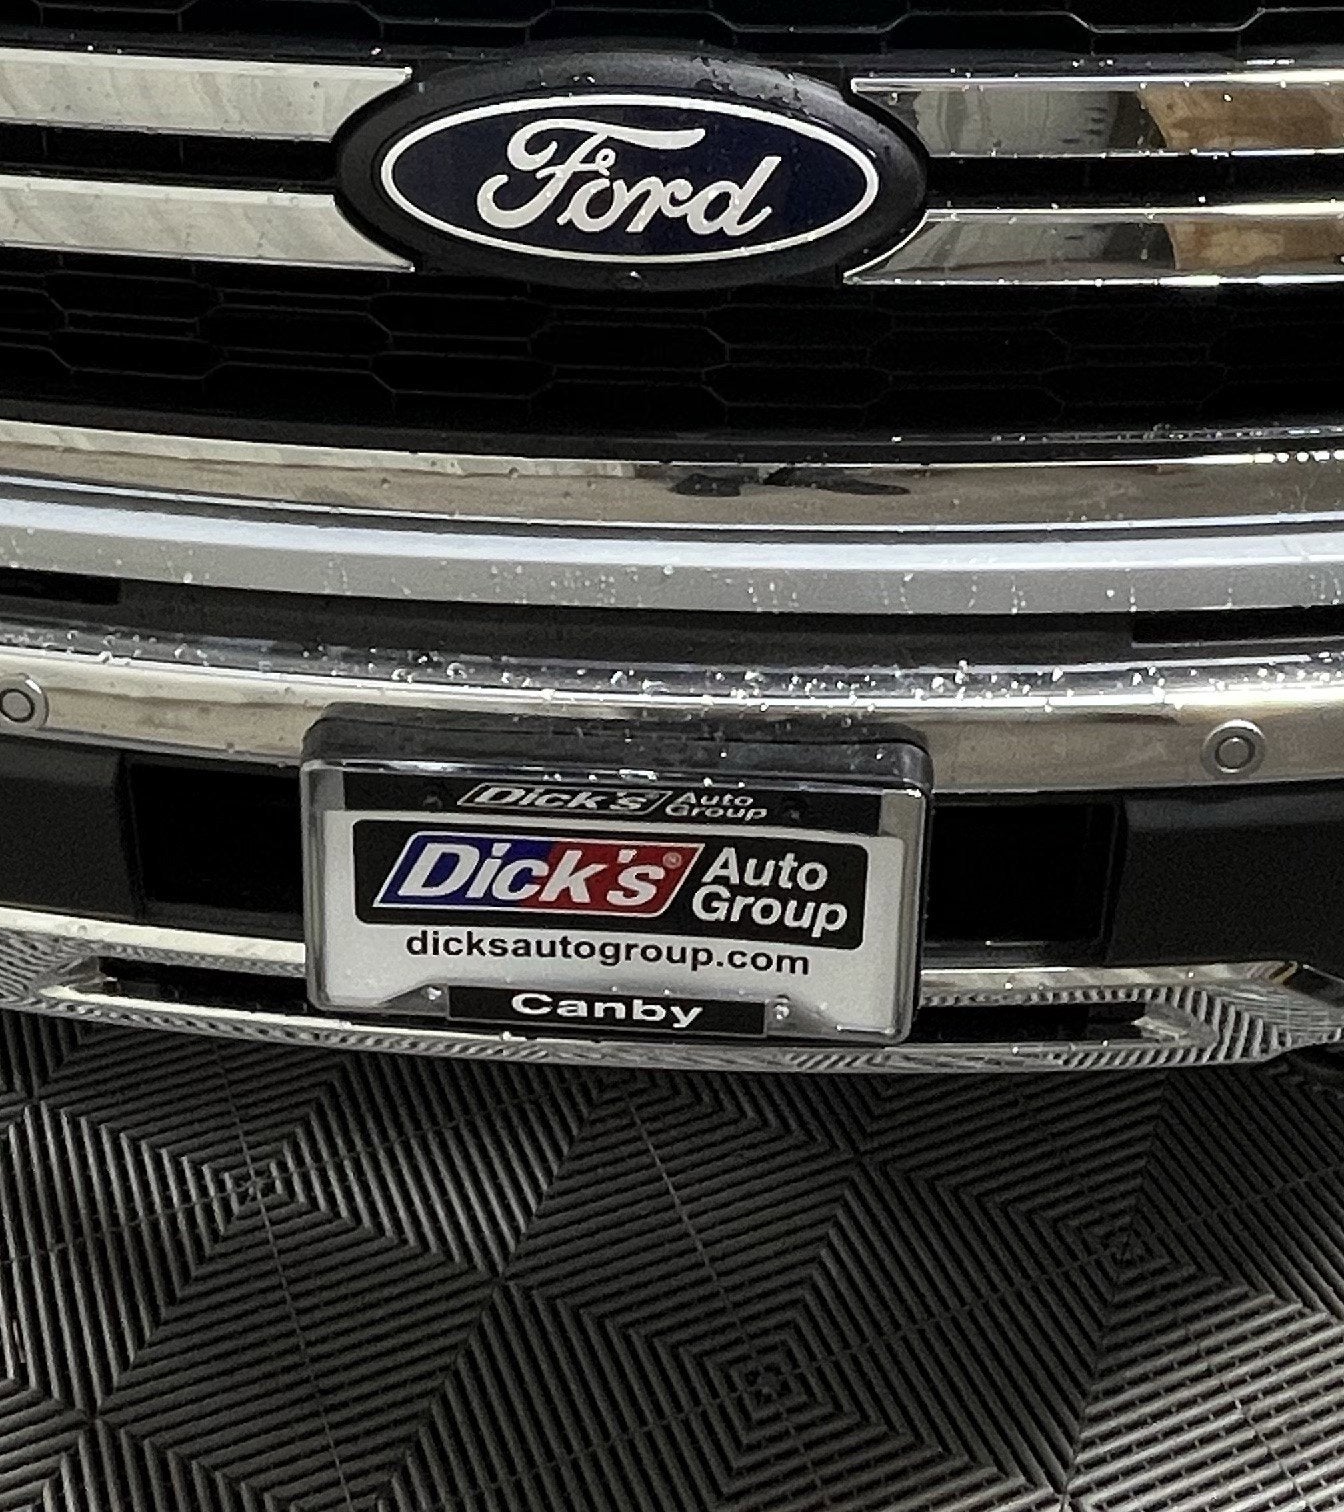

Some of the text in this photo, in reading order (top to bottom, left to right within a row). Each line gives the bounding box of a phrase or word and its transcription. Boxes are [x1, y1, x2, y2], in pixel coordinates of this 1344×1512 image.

[476, 117, 783, 237] Ford
[474, 787, 648, 811] Dick's
[665, 804, 767, 821] Group
[672, 791, 754, 807] Auto
[396, 841, 666, 907] Dick's
[701, 846, 828, 891] Auto
[692, 884, 848, 938] Group
[406, 931, 810, 975] dicksautogroup.com
[511, 993, 704, 1029] Canby
